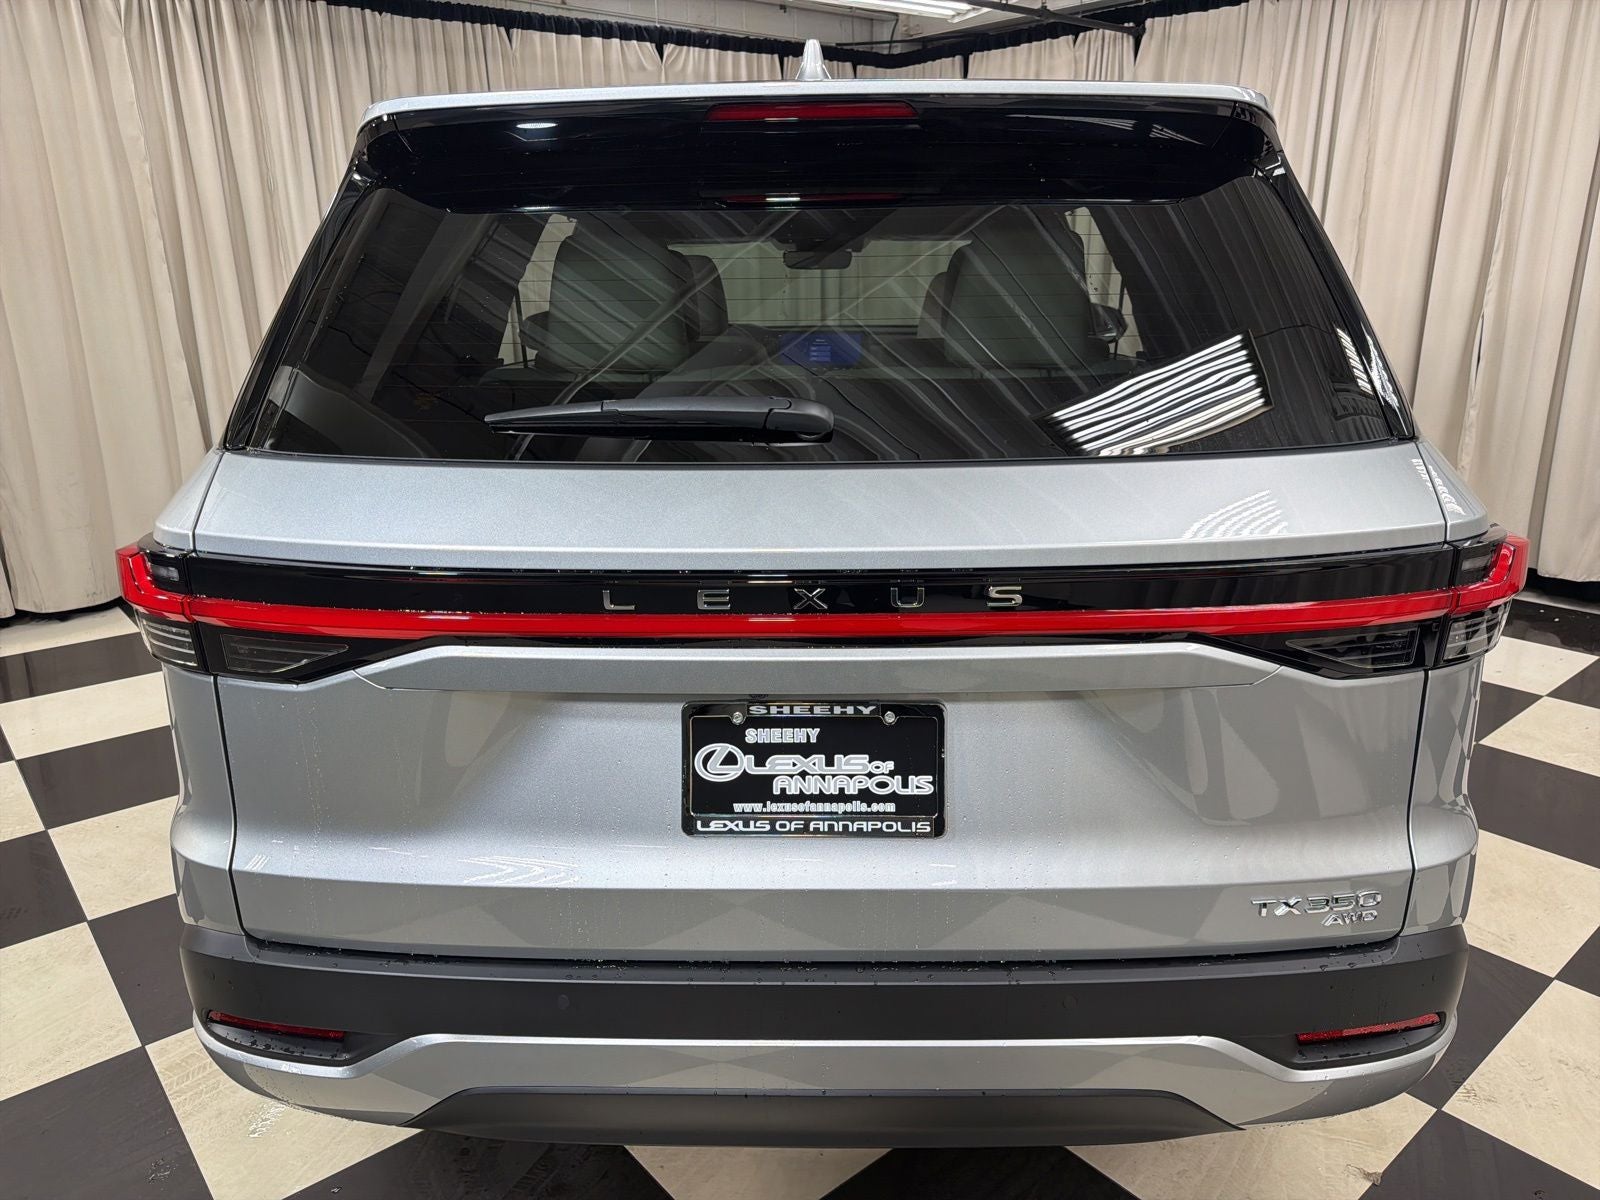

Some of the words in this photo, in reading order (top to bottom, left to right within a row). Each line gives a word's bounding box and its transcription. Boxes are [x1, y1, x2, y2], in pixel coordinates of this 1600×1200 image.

[602, 585, 1024, 611] LEXUS
[749, 704, 877, 715] SHEEHY
[745, 727, 821, 744] SHEEHY
[744, 754, 870, 774] LEXUS
[773, 775, 935, 795] ANNAPOLIS
[733, 801, 896, 814] www.lexusofannapolis.com
[696, 820, 771, 832] LEXUS
[775, 820, 804, 832] OF
[809, 820, 931, 833] ANNAPOLIS
[1321, 909, 1378, 927] AWD
